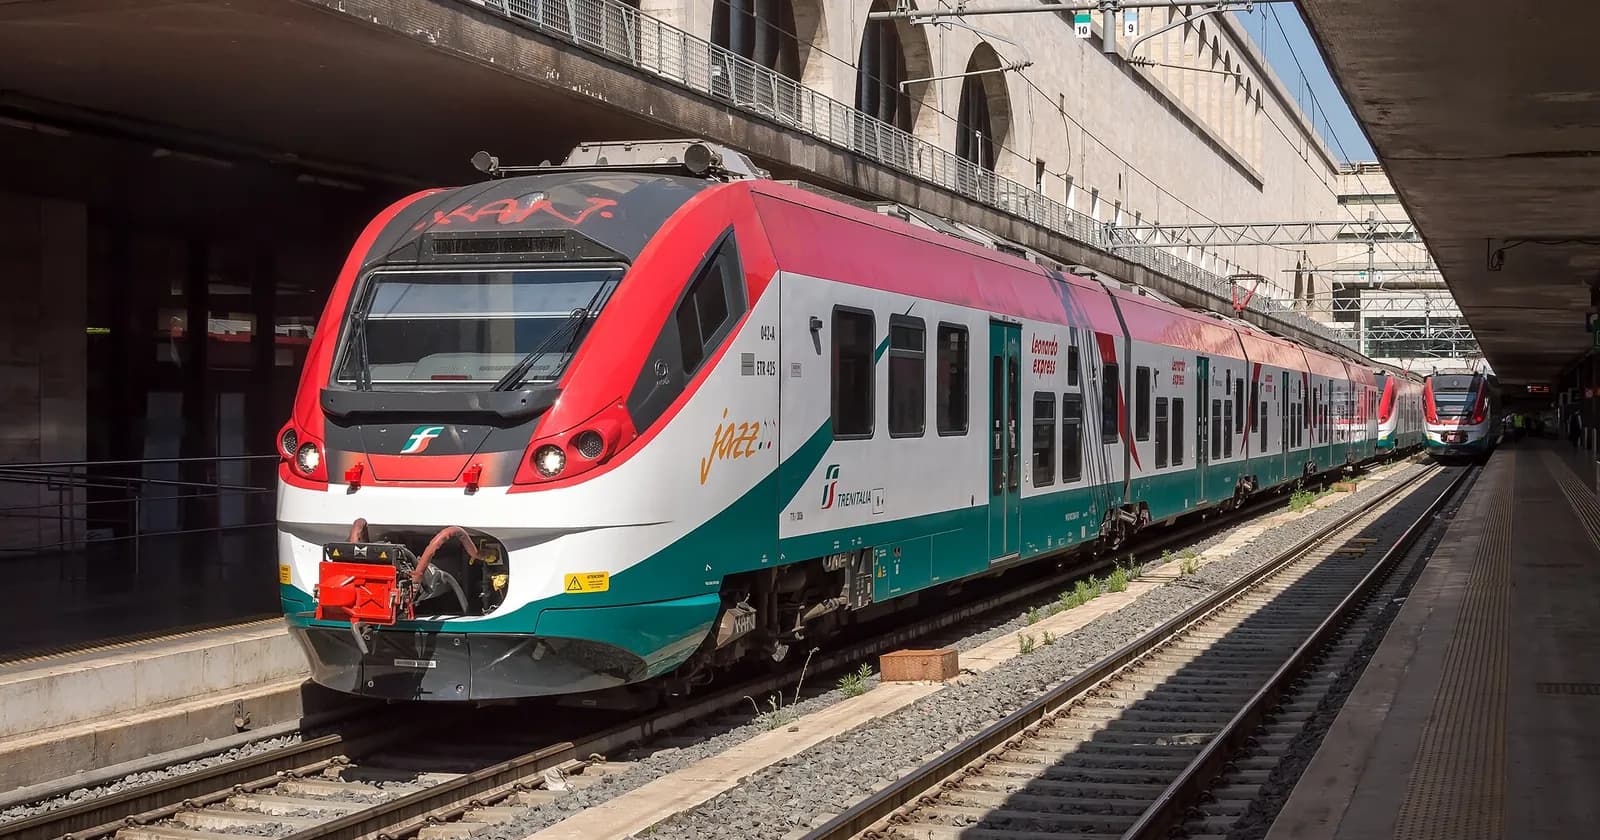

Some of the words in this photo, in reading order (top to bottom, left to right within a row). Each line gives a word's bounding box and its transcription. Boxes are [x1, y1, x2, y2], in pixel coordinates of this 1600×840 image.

[1078, 26, 1088, 35] 10
[1128, 24, 1134, 33] 9
[760, 325, 776, 341] 042-A
[1031, 332, 1058, 356] Leonardo
[756, 361, 766, 376] ETR
[1033, 358, 1056, 379] express
[700, 407, 760, 486] jazz
[837, 490, 872, 508] TRENITALIA
